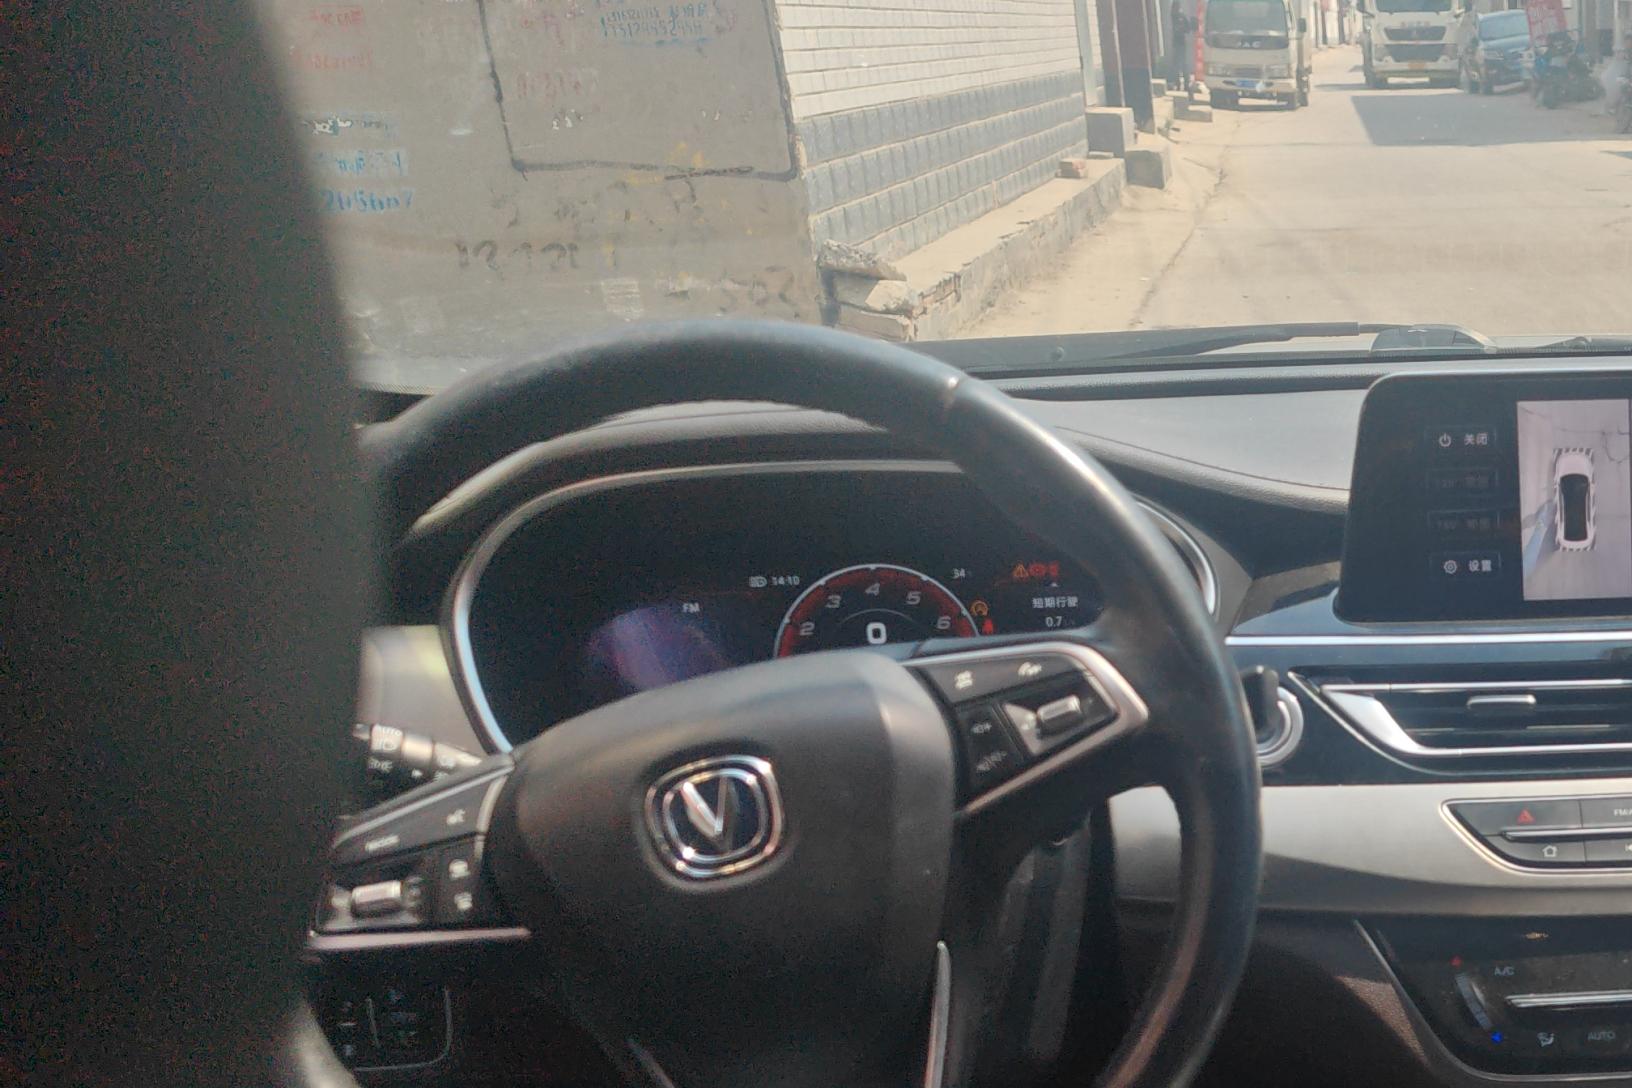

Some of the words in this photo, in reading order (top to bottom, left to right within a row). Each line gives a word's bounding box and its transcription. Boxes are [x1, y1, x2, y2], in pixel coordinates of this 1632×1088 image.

[1464, 433, 1488, 445] 关闭
[1468, 559, 1492, 572] 设置
[865, 583, 881, 596] 4
[825, 594, 841, 608] 3
[906, 591, 921, 605] 5
[1032, 596, 1078, 609] 短期行驶
[682, 602, 700, 613] FM
[936, 616, 951, 629] 6
[1045, 616, 1062, 627] 0.7
[799, 621, 815, 636] 2
[866, 622, 887, 644] 0
[1494, 966, 1515, 976] A/C
[1588, 1030, 1616, 1041] AUTO
